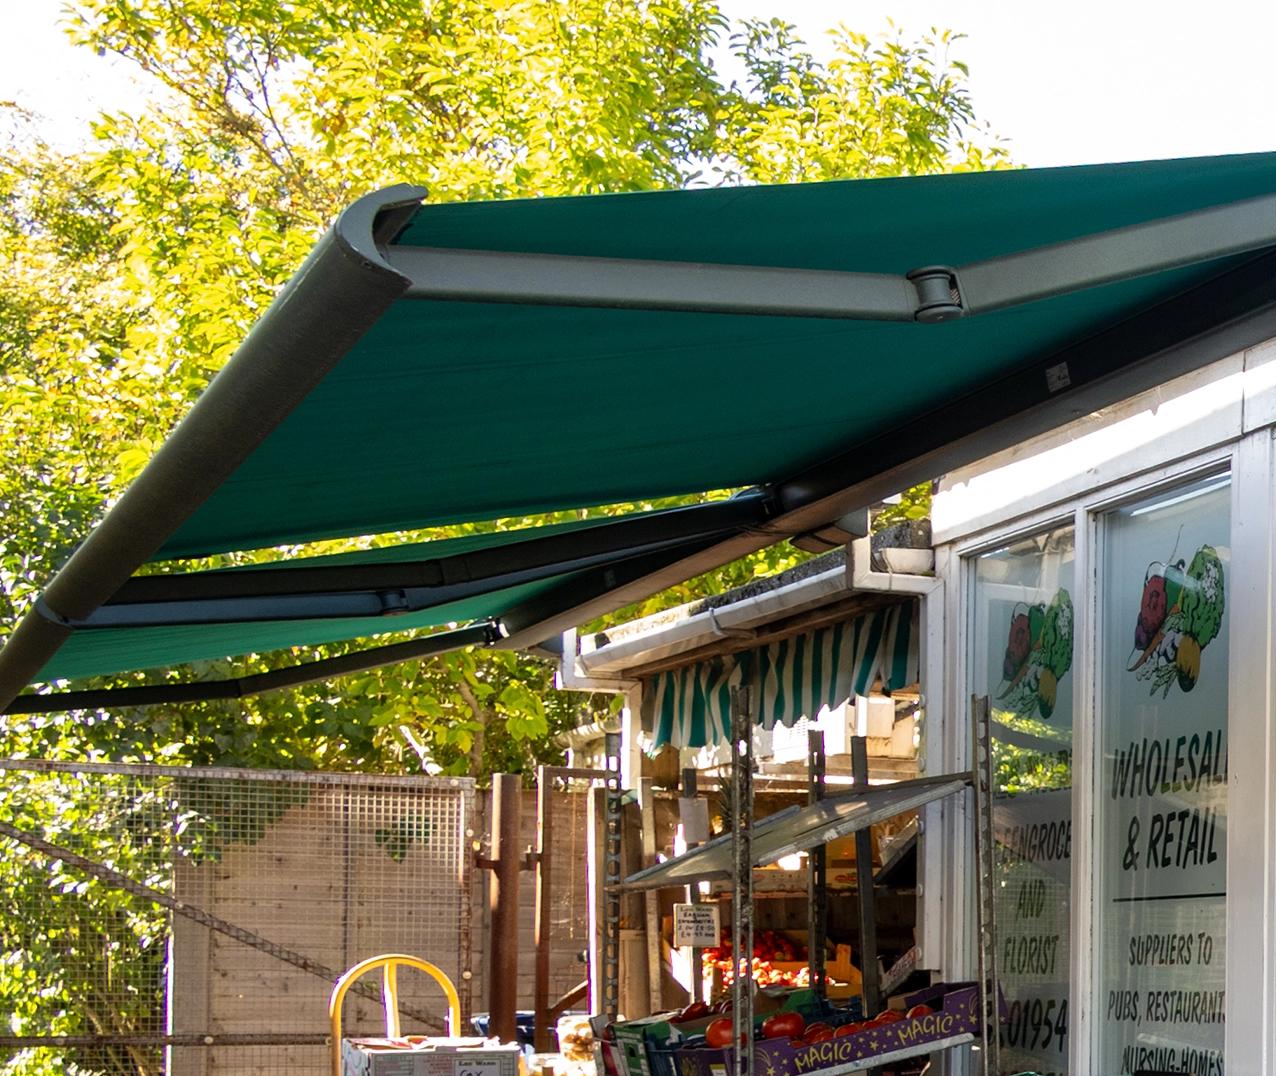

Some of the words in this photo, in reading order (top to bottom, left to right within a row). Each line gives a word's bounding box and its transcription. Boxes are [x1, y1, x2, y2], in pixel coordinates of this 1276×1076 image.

[1122, 816, 1141, 872] &
[1145, 806, 1219, 869] RETAIL
[1015, 880, 1046, 920] AND
[1002, 935, 1059, 976] FLORIST
[1128, 934, 1195, 967] SUPPLIERS
[1196, 931, 1213, 966] TO
[1007, 998, 1068, 1053] 01954
[1107, 990, 1143, 1027] PUBS,
[897, 1015, 954, 1046] MAGIC
[794, 1042, 852, 1073] MAGIC
